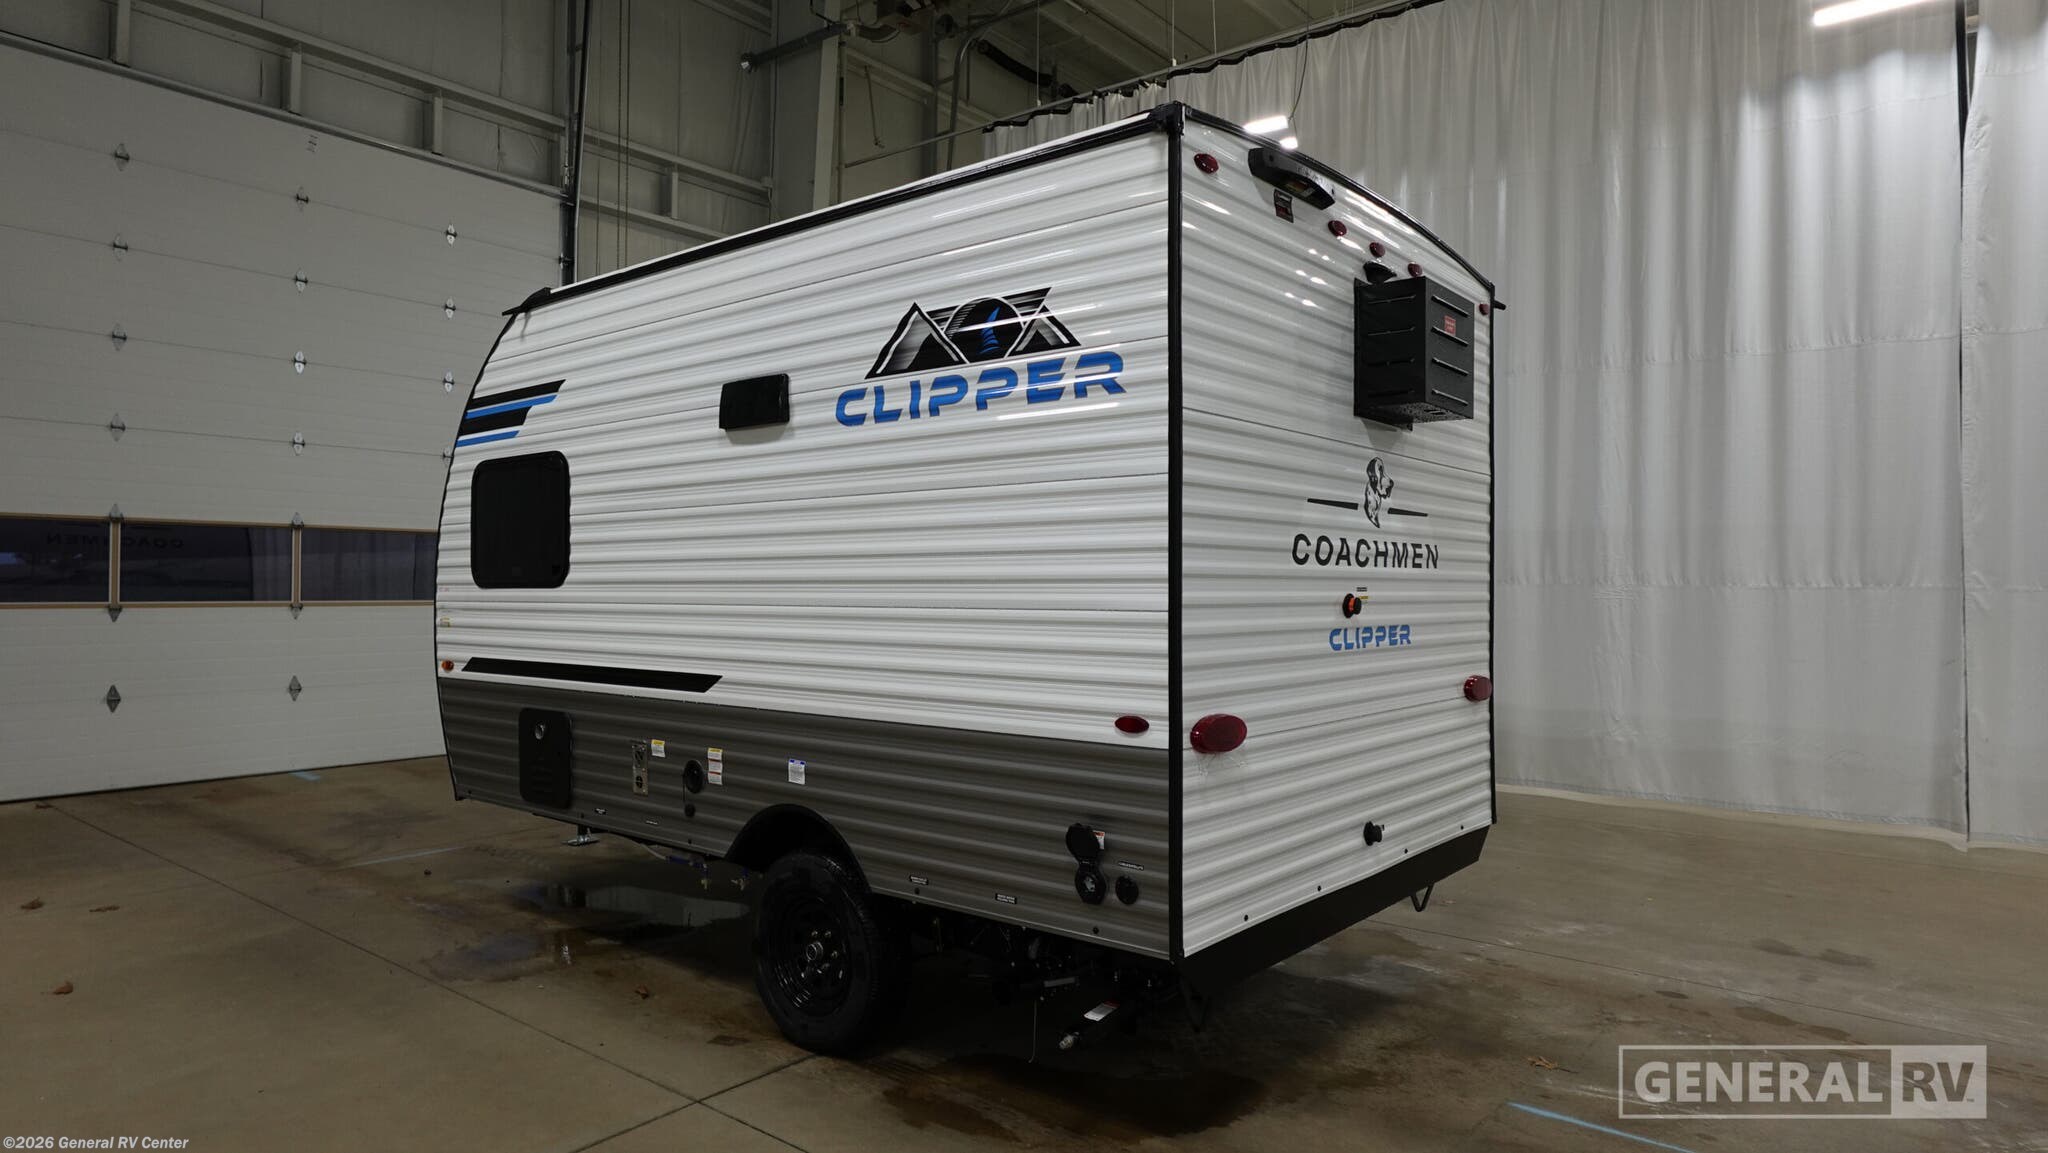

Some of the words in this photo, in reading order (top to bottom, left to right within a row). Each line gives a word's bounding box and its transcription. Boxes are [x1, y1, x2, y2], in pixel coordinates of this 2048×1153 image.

[835, 350, 1127, 427] CLIPPER
[1291, 533, 1439, 569] COACHMEN
[1329, 624, 1412, 651] CLIPPER
